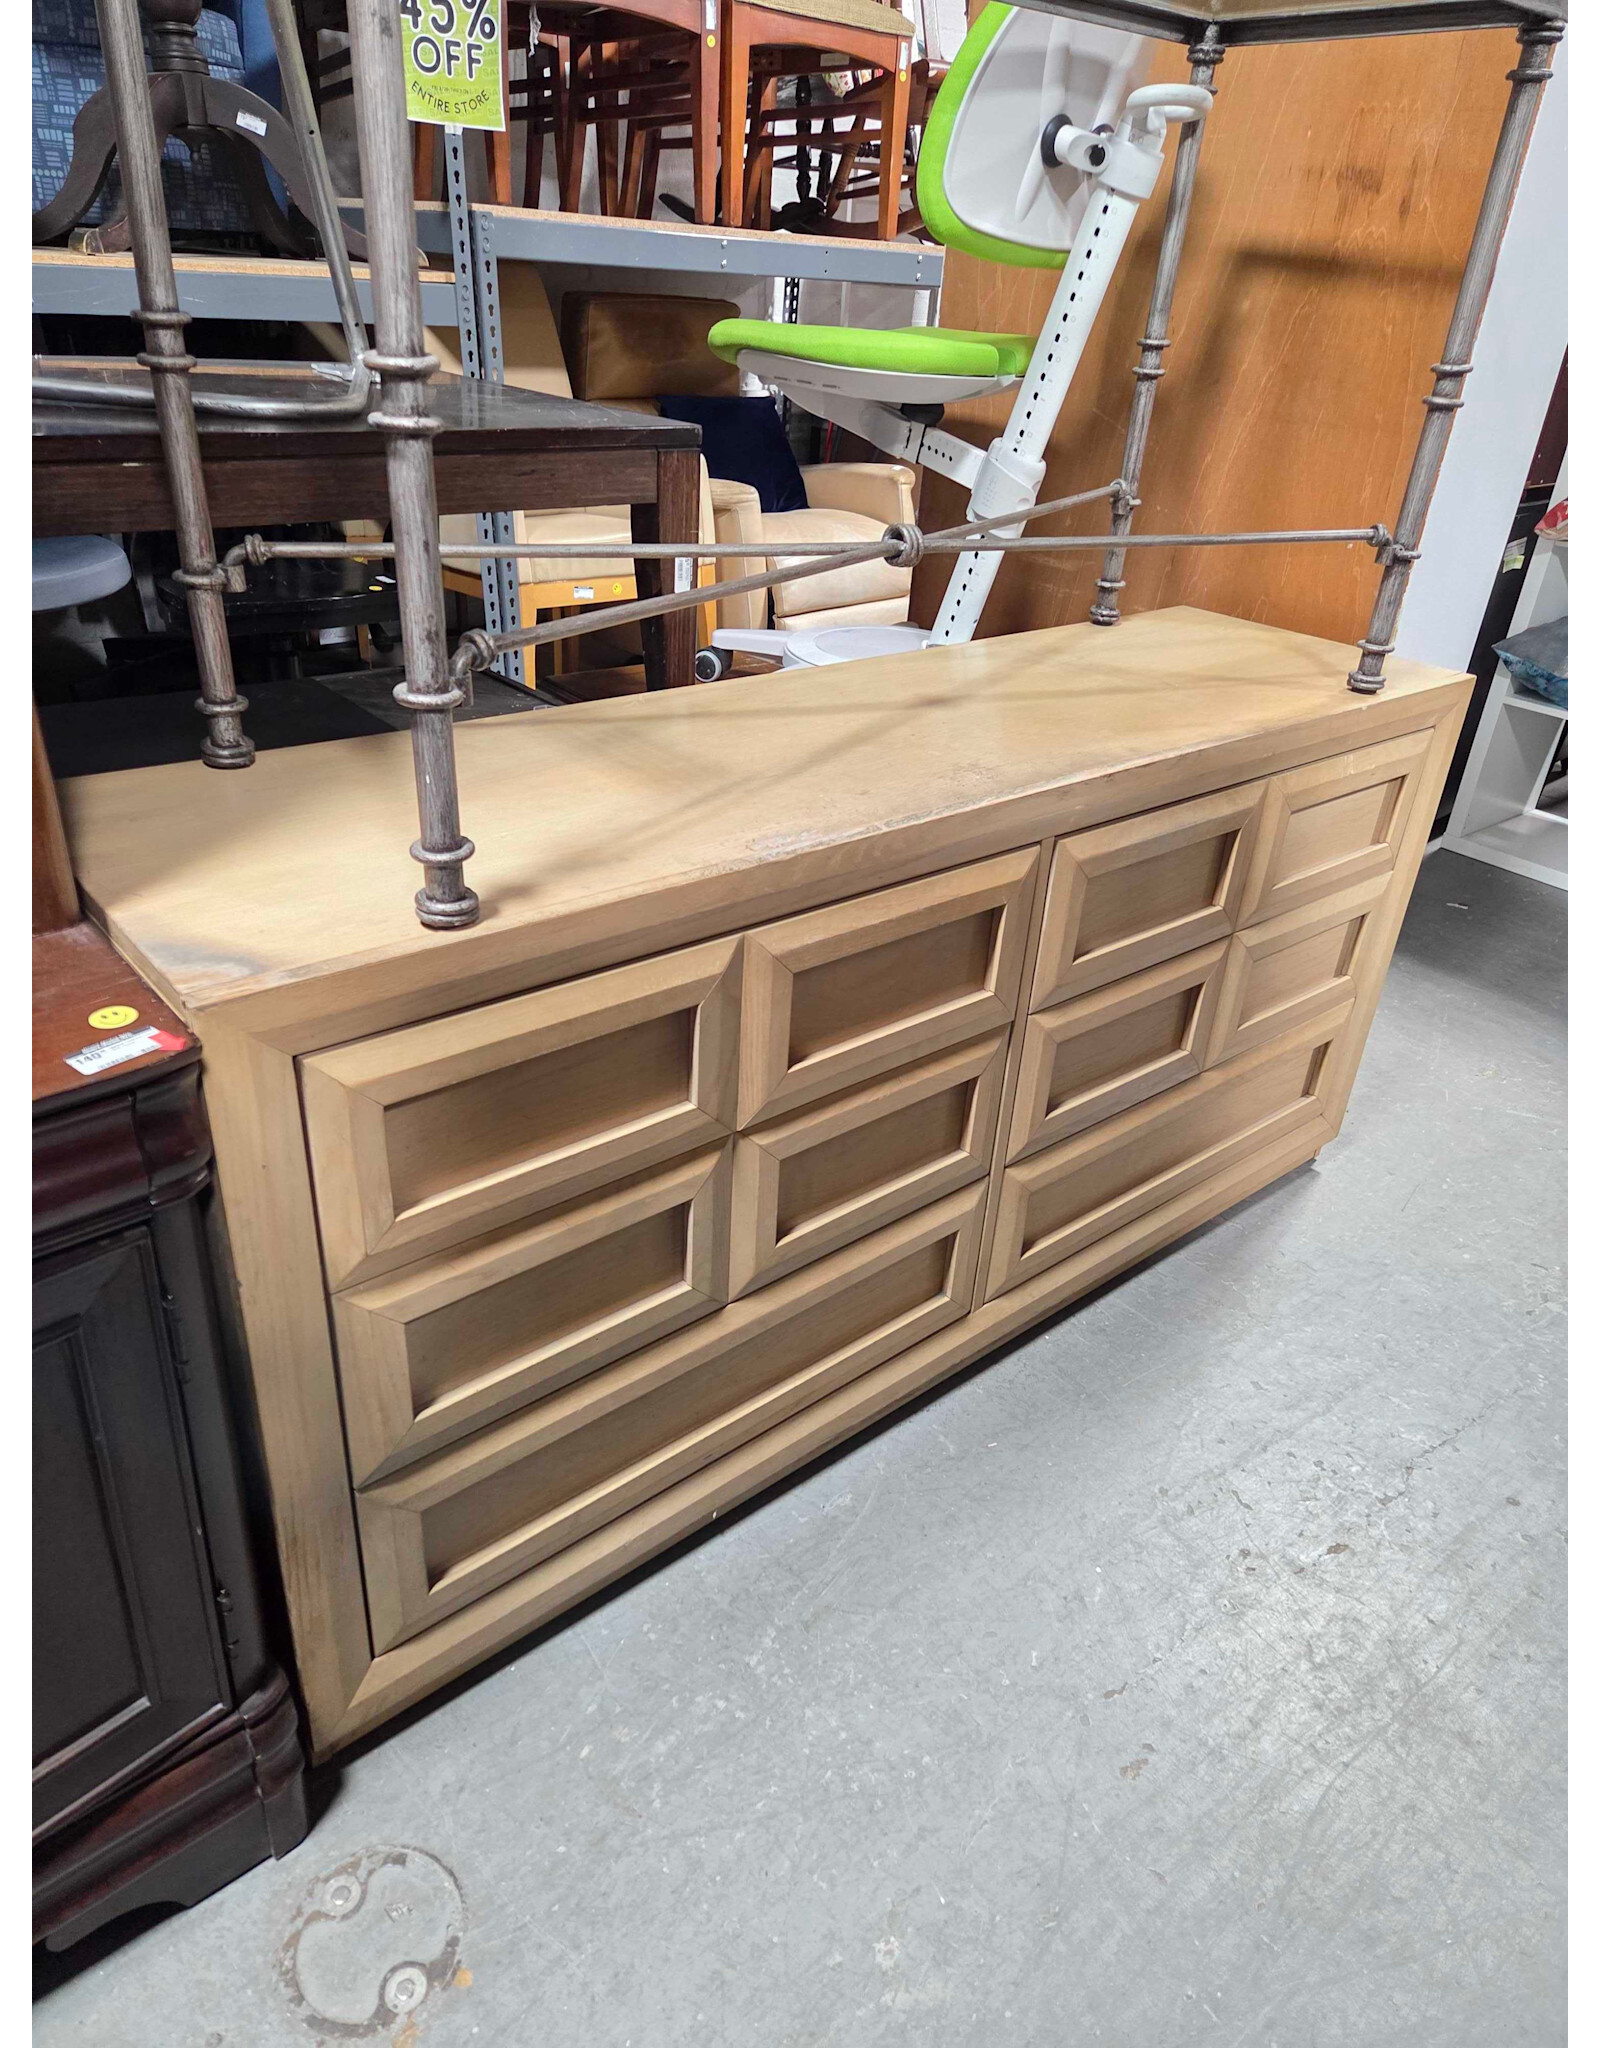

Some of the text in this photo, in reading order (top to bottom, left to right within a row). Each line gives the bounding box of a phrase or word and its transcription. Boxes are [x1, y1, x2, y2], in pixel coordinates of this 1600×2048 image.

[413, 36, 483, 79] OFF
[411, 80, 490, 114] ENTIRE STORE
